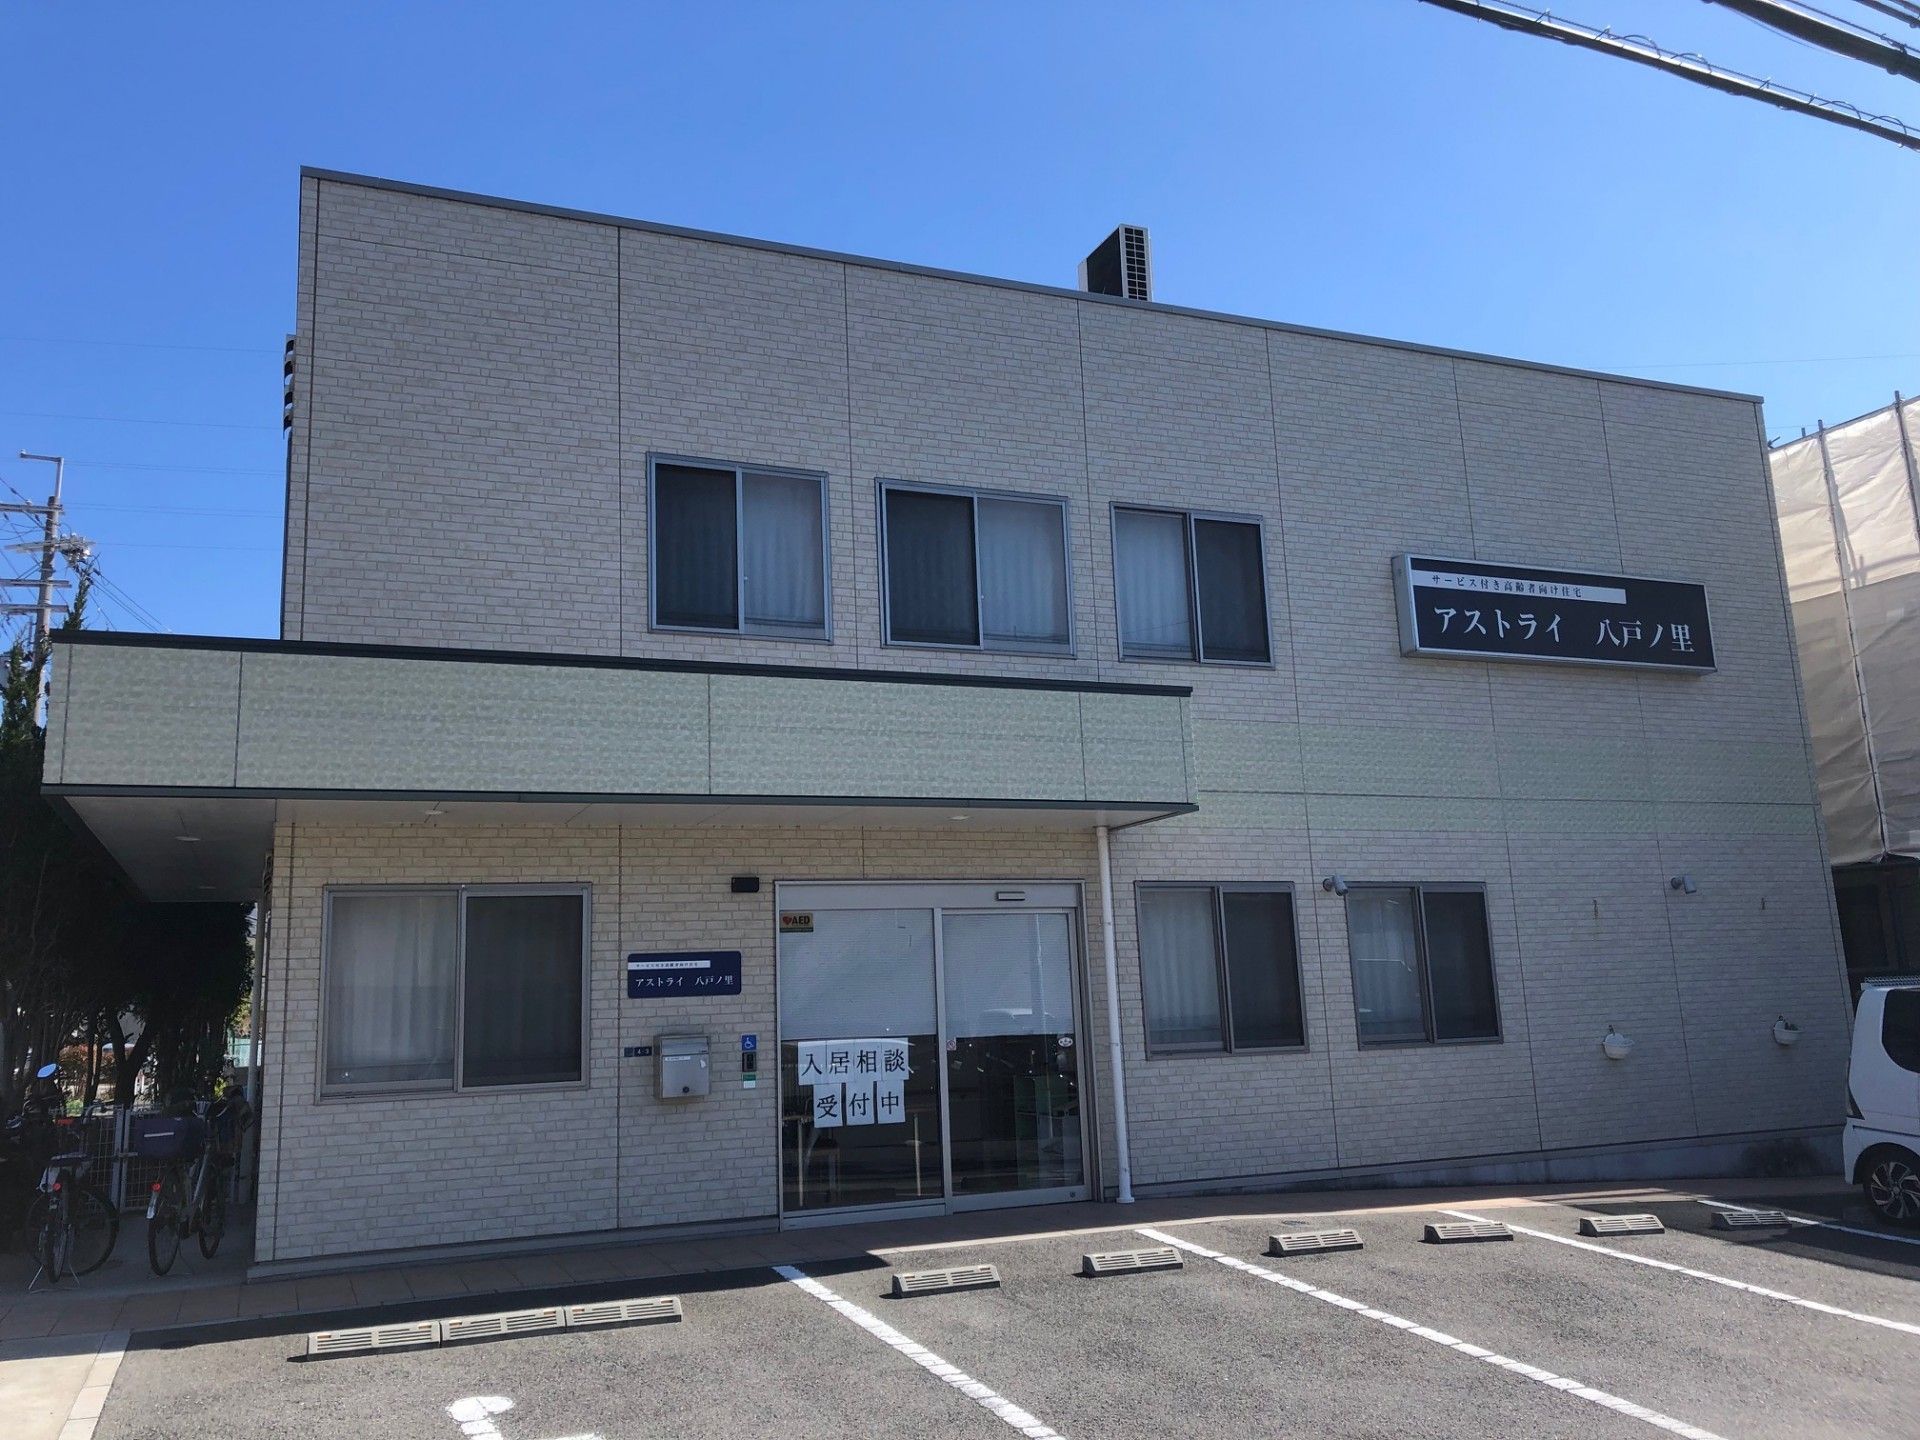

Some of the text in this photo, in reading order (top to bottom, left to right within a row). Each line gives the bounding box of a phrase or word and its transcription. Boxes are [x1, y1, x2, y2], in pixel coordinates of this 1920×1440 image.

[1431, 574, 1583, 598] サービス付き高齢者向け住宅
[1433, 607, 1696, 652] アストライ 八戸ノ里
[791, 915, 811, 925] AED
[635, 975, 734, 988] アストライ 八戸ノ里
[801, 1048, 906, 1076] 入居相談
[816, 1090, 900, 1119] 受付中
